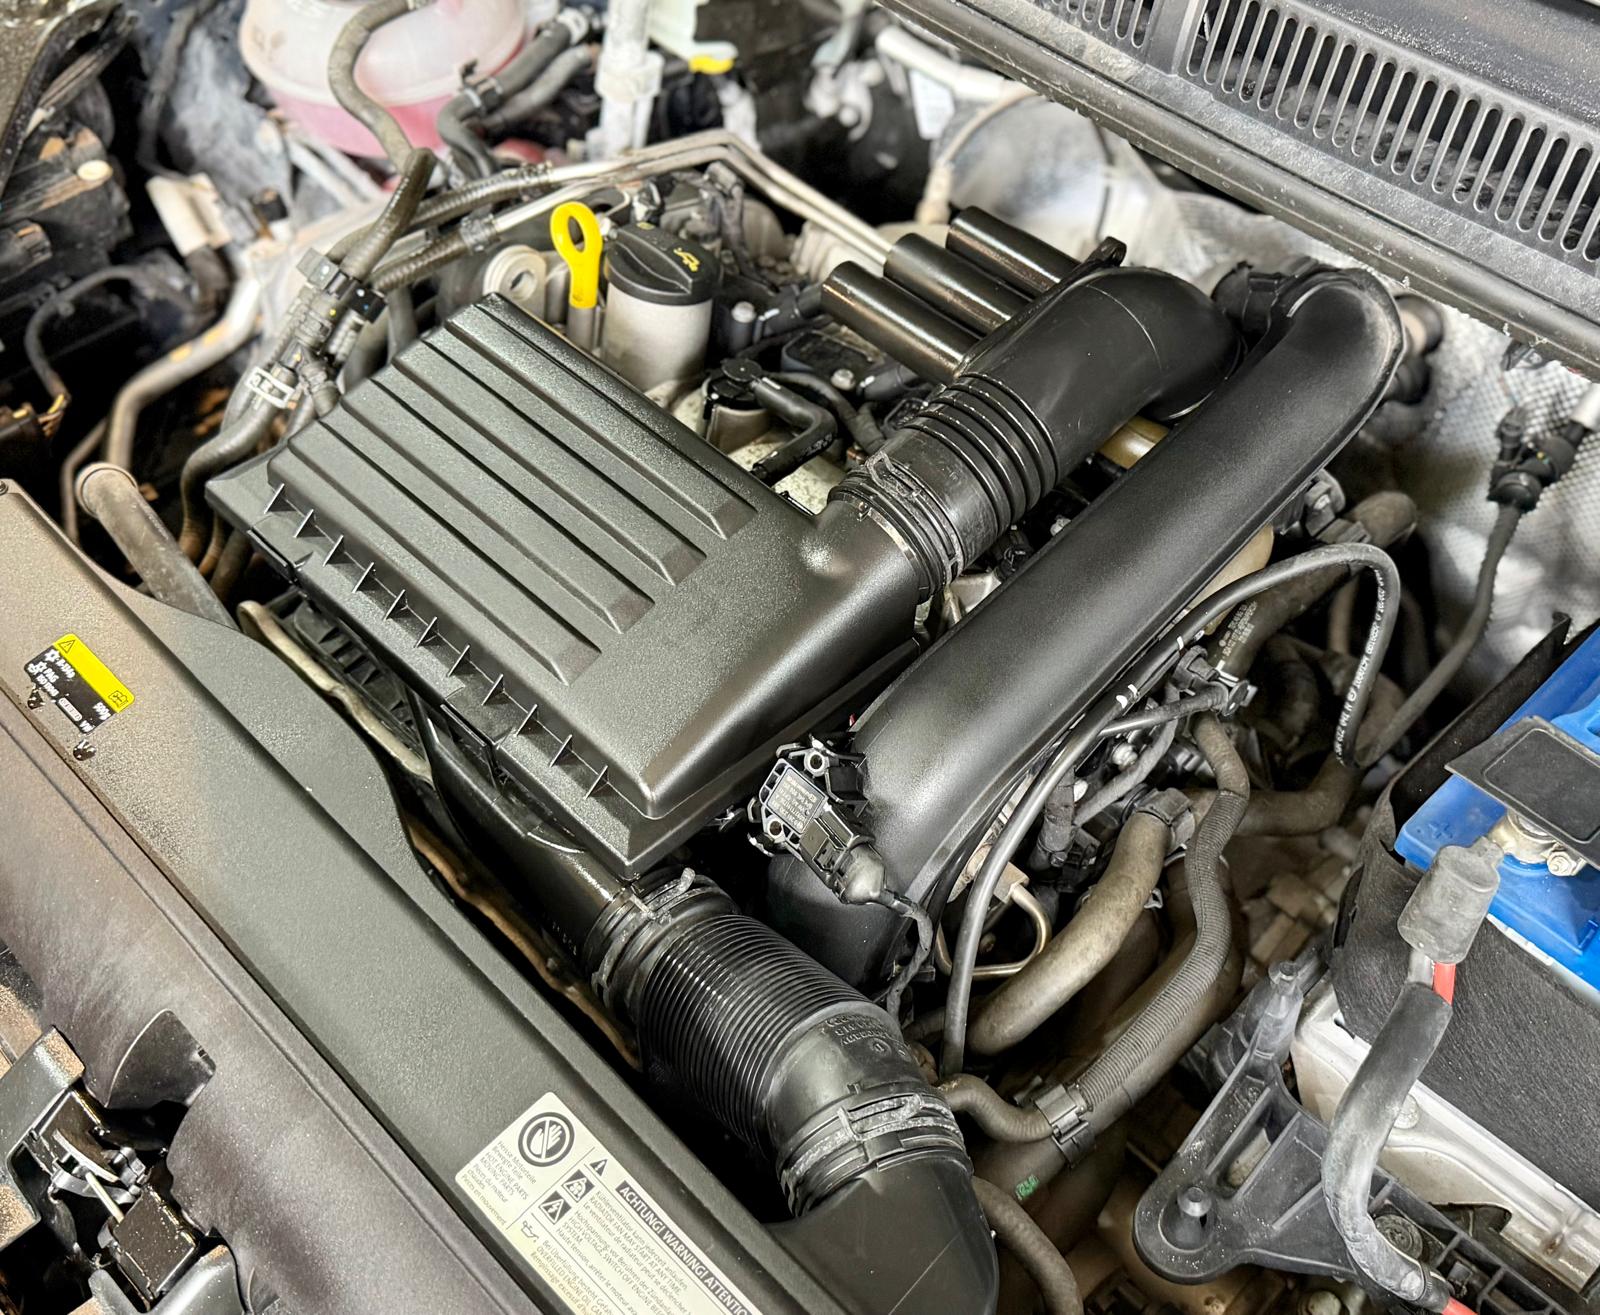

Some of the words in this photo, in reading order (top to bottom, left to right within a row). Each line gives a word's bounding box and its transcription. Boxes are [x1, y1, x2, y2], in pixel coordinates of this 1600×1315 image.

[511, 1182, 529, 1200] PARTS
[617, 1184, 667, 1234] ACHTUNG!
[660, 1228, 710, 1280] WARNING!
